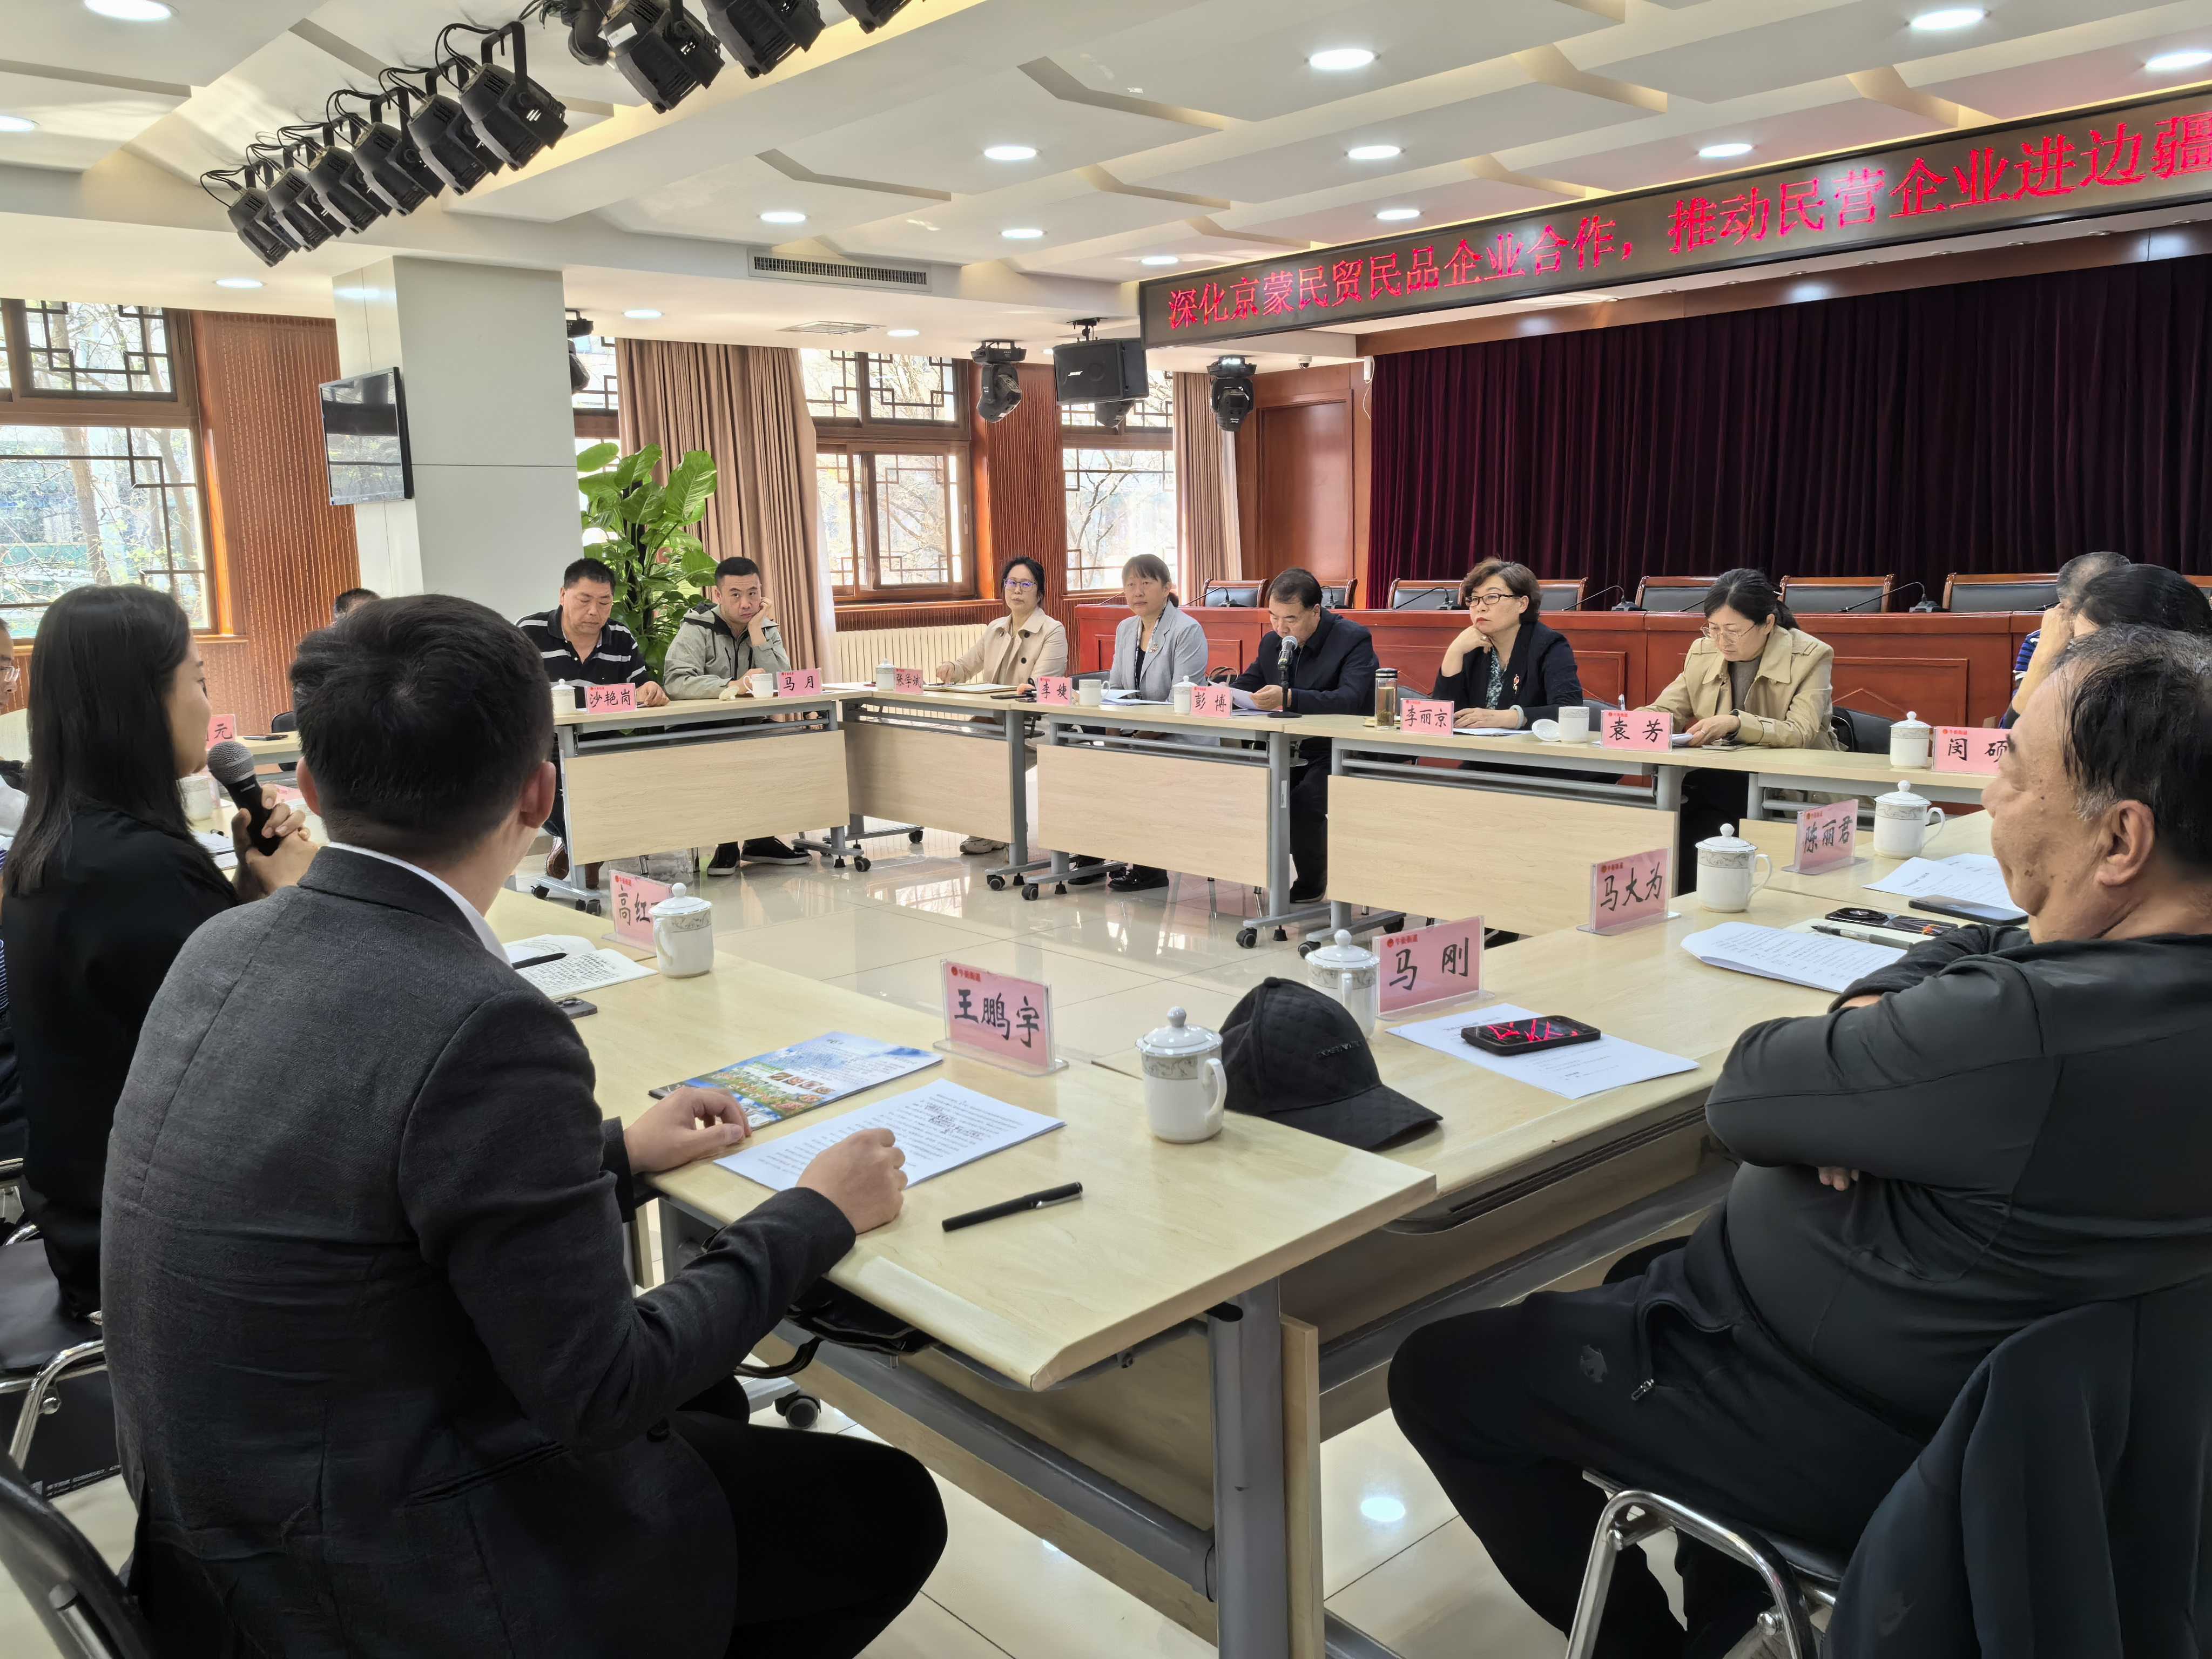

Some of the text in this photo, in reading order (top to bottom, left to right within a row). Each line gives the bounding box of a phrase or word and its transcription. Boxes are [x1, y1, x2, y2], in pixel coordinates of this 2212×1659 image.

[783, 676, 814, 691] 马月
[590, 689, 630, 708] 沙艳岗
[1195, 692, 1226, 712] 彭博
[1405, 704, 1447, 727] 李丽京
[206, 723, 232, 741] 元
[1609, 717, 1663, 743] 袁芳
[1600, 861, 1663, 911] 马大为
[618, 884, 661, 926] 高红
[1389, 937, 1469, 990] 马刚
[954, 989, 1040, 1048] 王鹏宇
